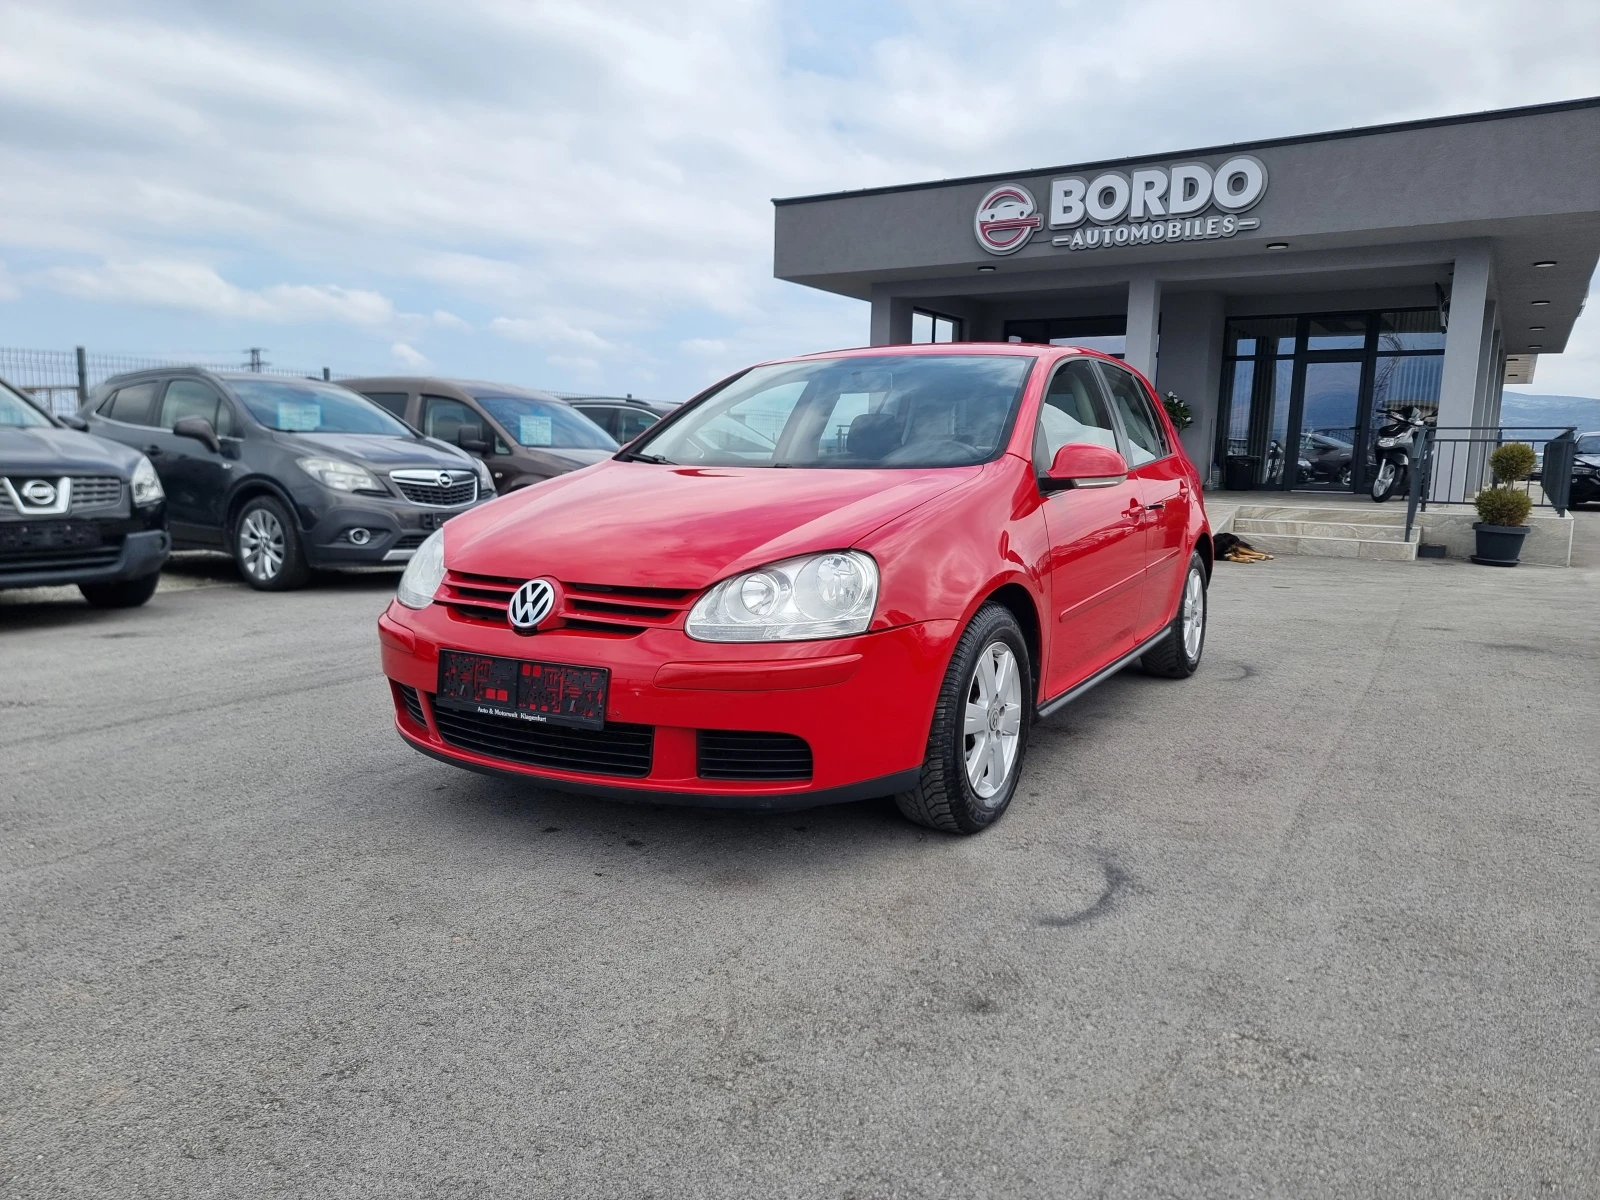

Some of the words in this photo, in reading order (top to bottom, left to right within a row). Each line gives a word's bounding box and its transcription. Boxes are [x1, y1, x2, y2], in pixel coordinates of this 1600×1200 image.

[1051, 157, 1264, 226] BORDO
[1071, 216, 1235, 248] AUTOMOBILES
[477, 706, 489, 714] Auto
[520, 712, 547, 722] Klagenfurt
